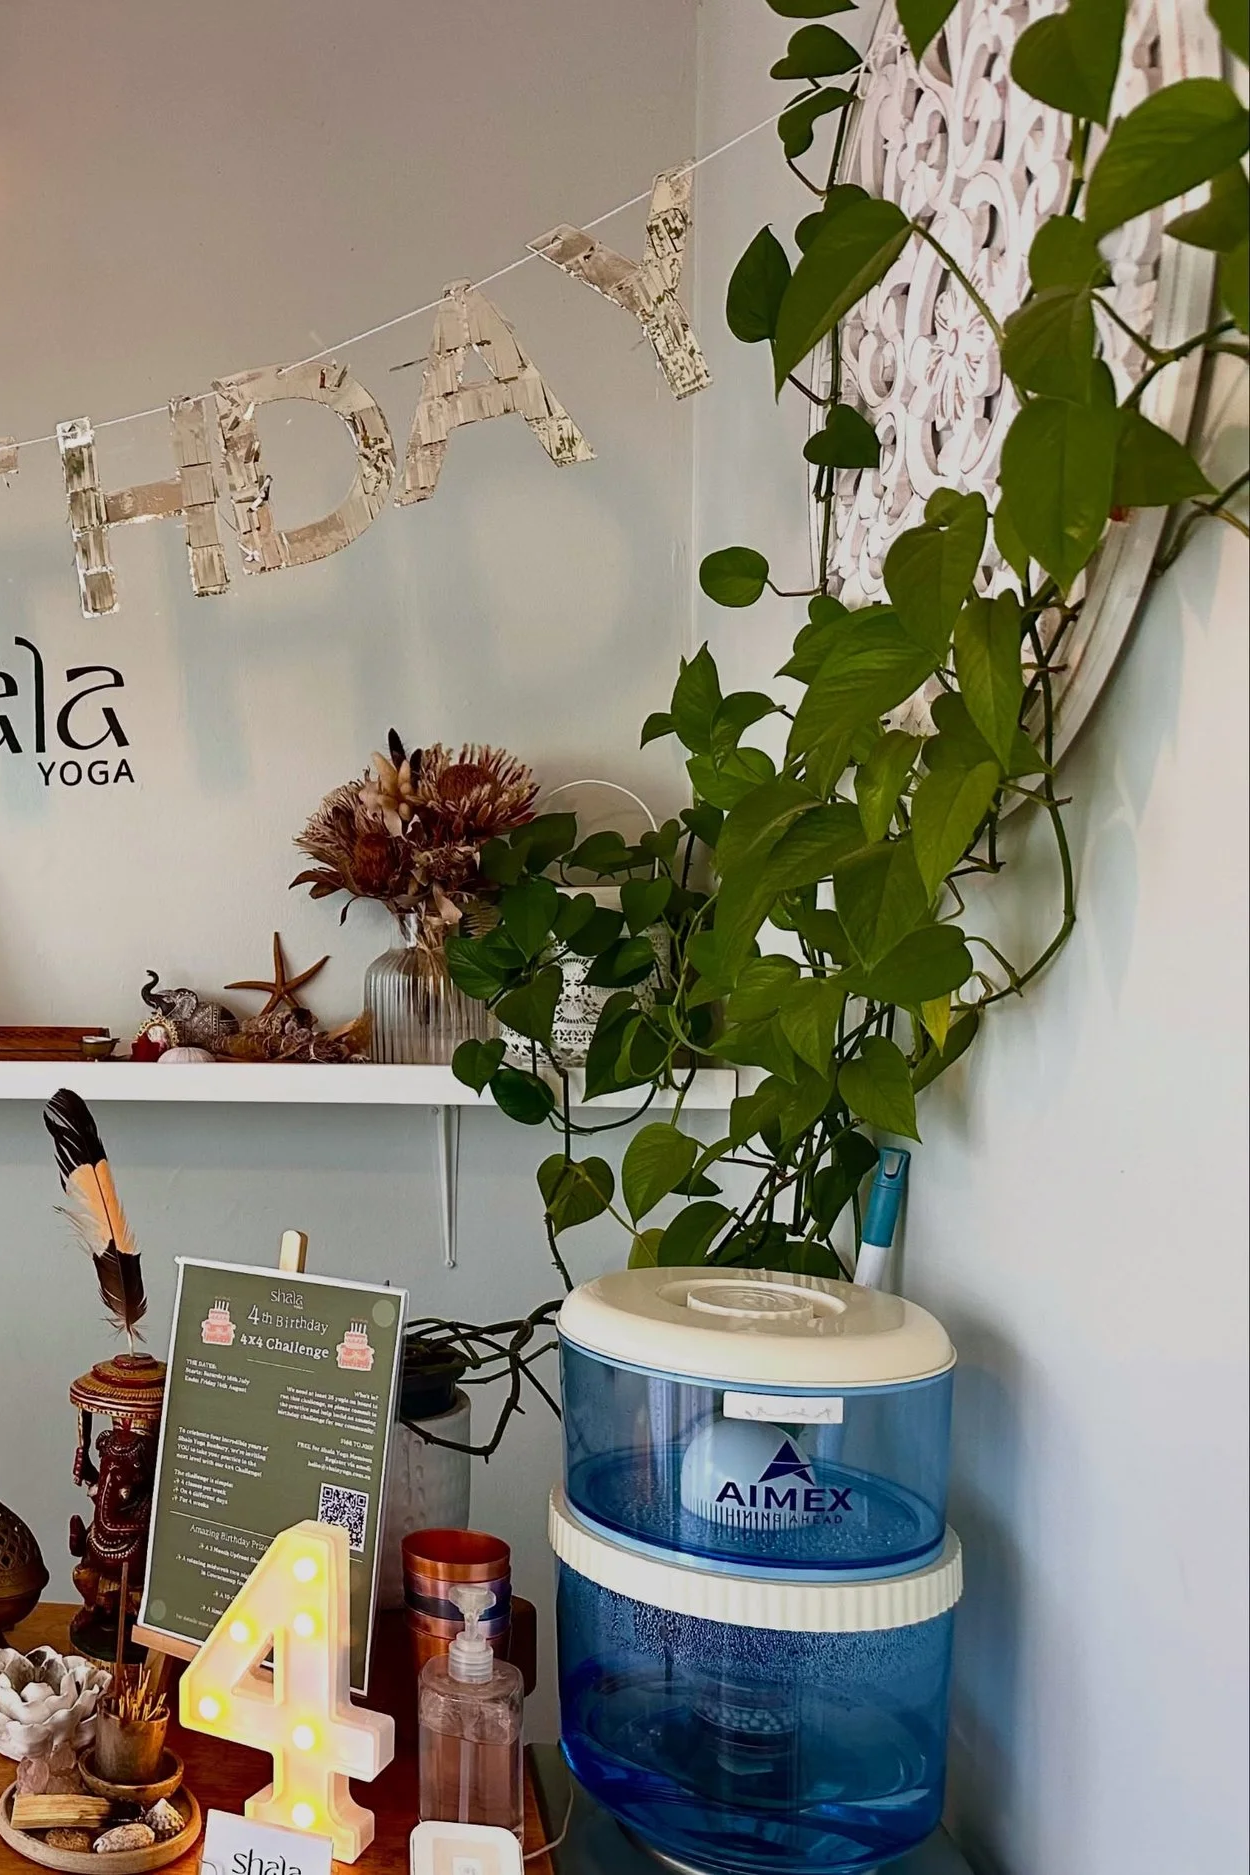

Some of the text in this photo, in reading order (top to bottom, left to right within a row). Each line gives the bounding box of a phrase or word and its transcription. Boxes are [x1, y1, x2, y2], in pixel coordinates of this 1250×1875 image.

[38, 758, 135, 787] YOGA
[270, 1288, 304, 1306] shala
[248, 1305, 328, 1335] 4th Birthday
[266, 1338, 329, 1360] Challenge
[177, 1443, 189, 1451] YOU
[193, 1438, 205, 1446] Yoga
[336, 1450, 348, 1458] Yoga
[715, 1481, 853, 1512] AIMEX
[790, 1514, 843, 1524] AHEAD
[190, 1524, 220, 1540] Amazing
[221, 1532, 250, 1548] Birthday
